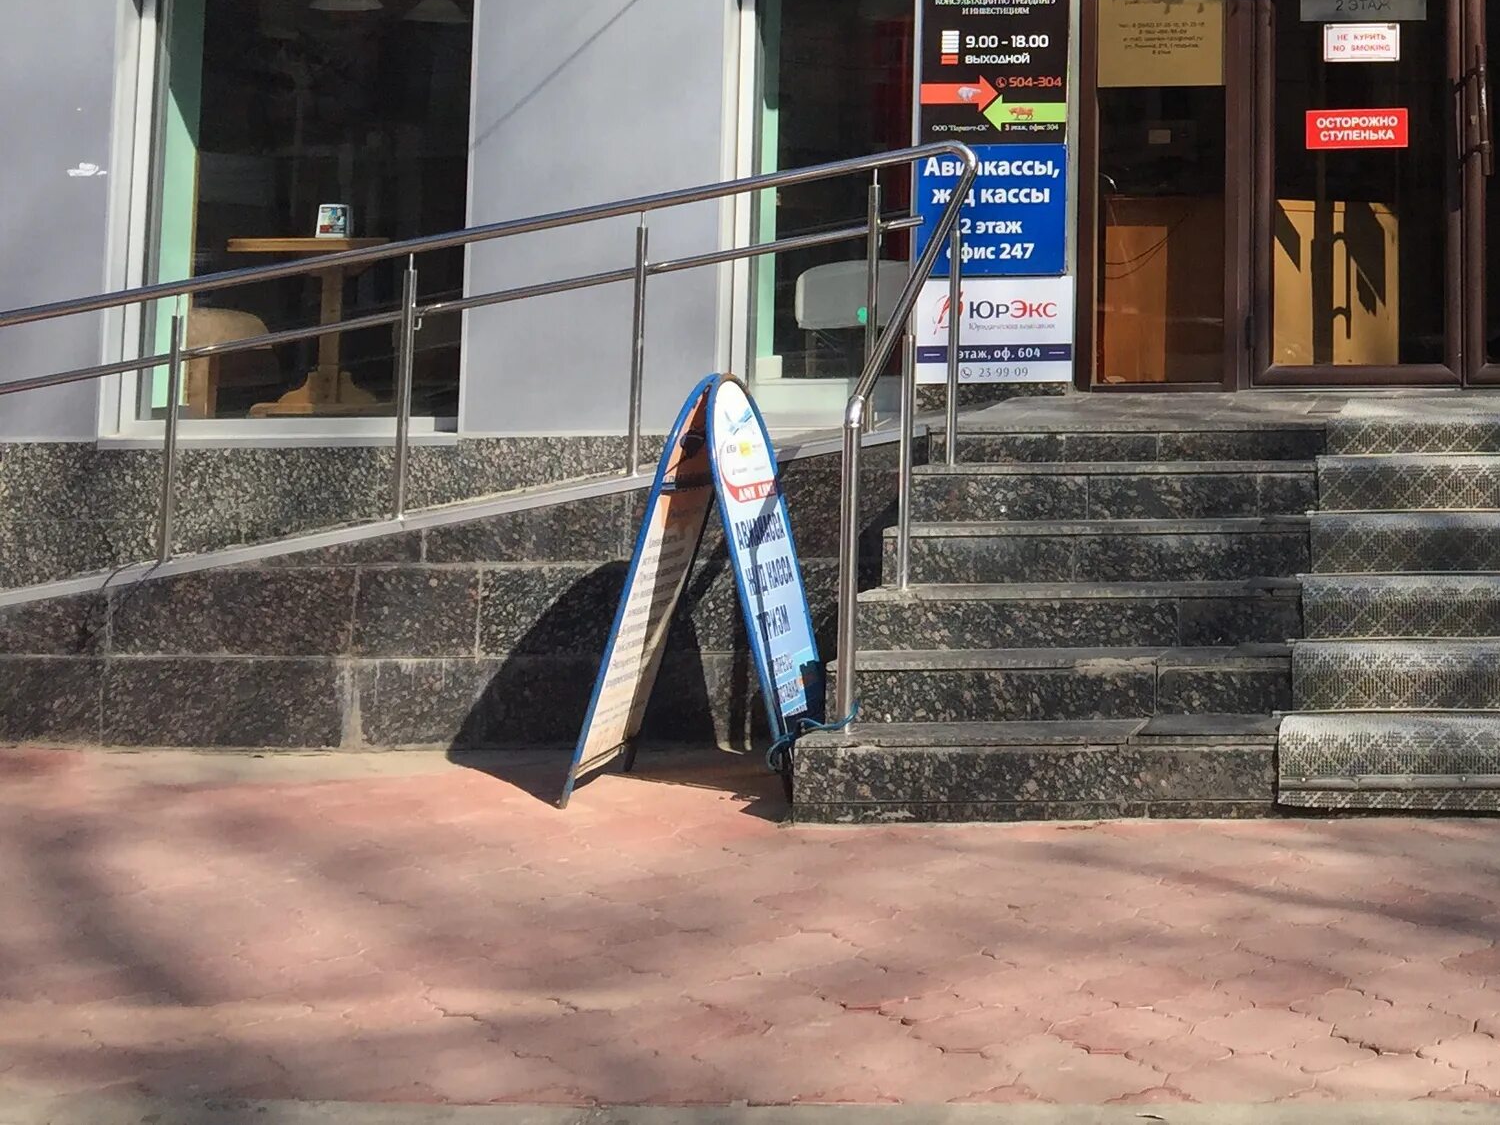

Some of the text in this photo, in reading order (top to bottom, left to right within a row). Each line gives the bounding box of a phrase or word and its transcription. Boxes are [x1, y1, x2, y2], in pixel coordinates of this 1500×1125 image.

[1335, 0, 1344, 12] 2
[965, 35, 999, 48] 9.00
[1011, 34, 1049, 48] 18.00
[1337, 33, 1387, 41] НЕ КУРИТЬ
[1333, 43, 1391, 52] NO SMOKING
[965, 52, 1030, 64] ВЫХОДНОЙ
[1008, 76, 1062, 88] 504-304
[1316, 115, 1399, 129] ОСТОРОЖНО
[1319, 129, 1396, 142] СТУПЕНЬКА
[981, 187, 1050, 204] кассы
[975, 220, 1023, 234] этаж
[999, 242, 1035, 259] 247
[994, 347, 1015, 361] оф.
[1018, 347, 1041, 359] 604
[765, 556, 795, 590] КАССА
